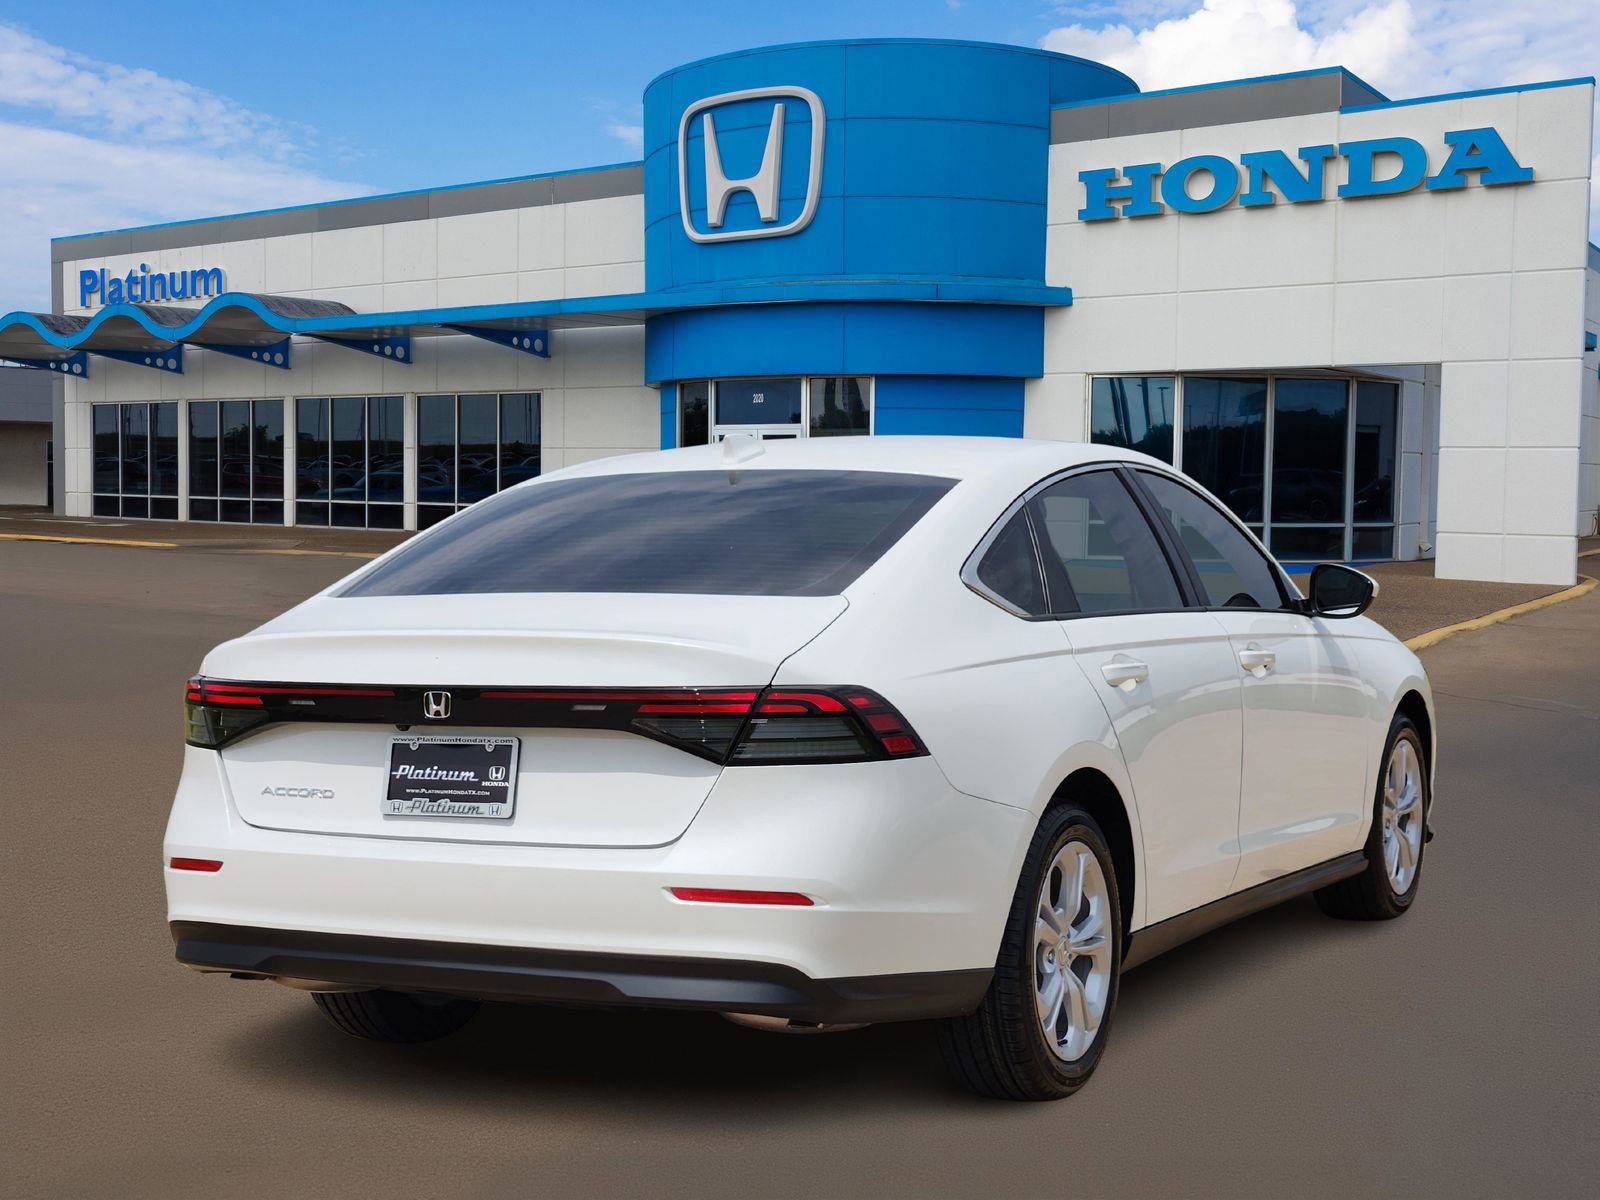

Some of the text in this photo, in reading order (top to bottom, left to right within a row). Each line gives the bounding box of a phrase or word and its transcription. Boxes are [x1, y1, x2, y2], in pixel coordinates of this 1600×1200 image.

[1078, 127, 1534, 221] HONDA
[79, 263, 225, 307] Platinum
[391, 765, 479, 781] Platinum
[261, 786, 335, 799] ACCORD
[405, 799, 484, 815] Platinum
